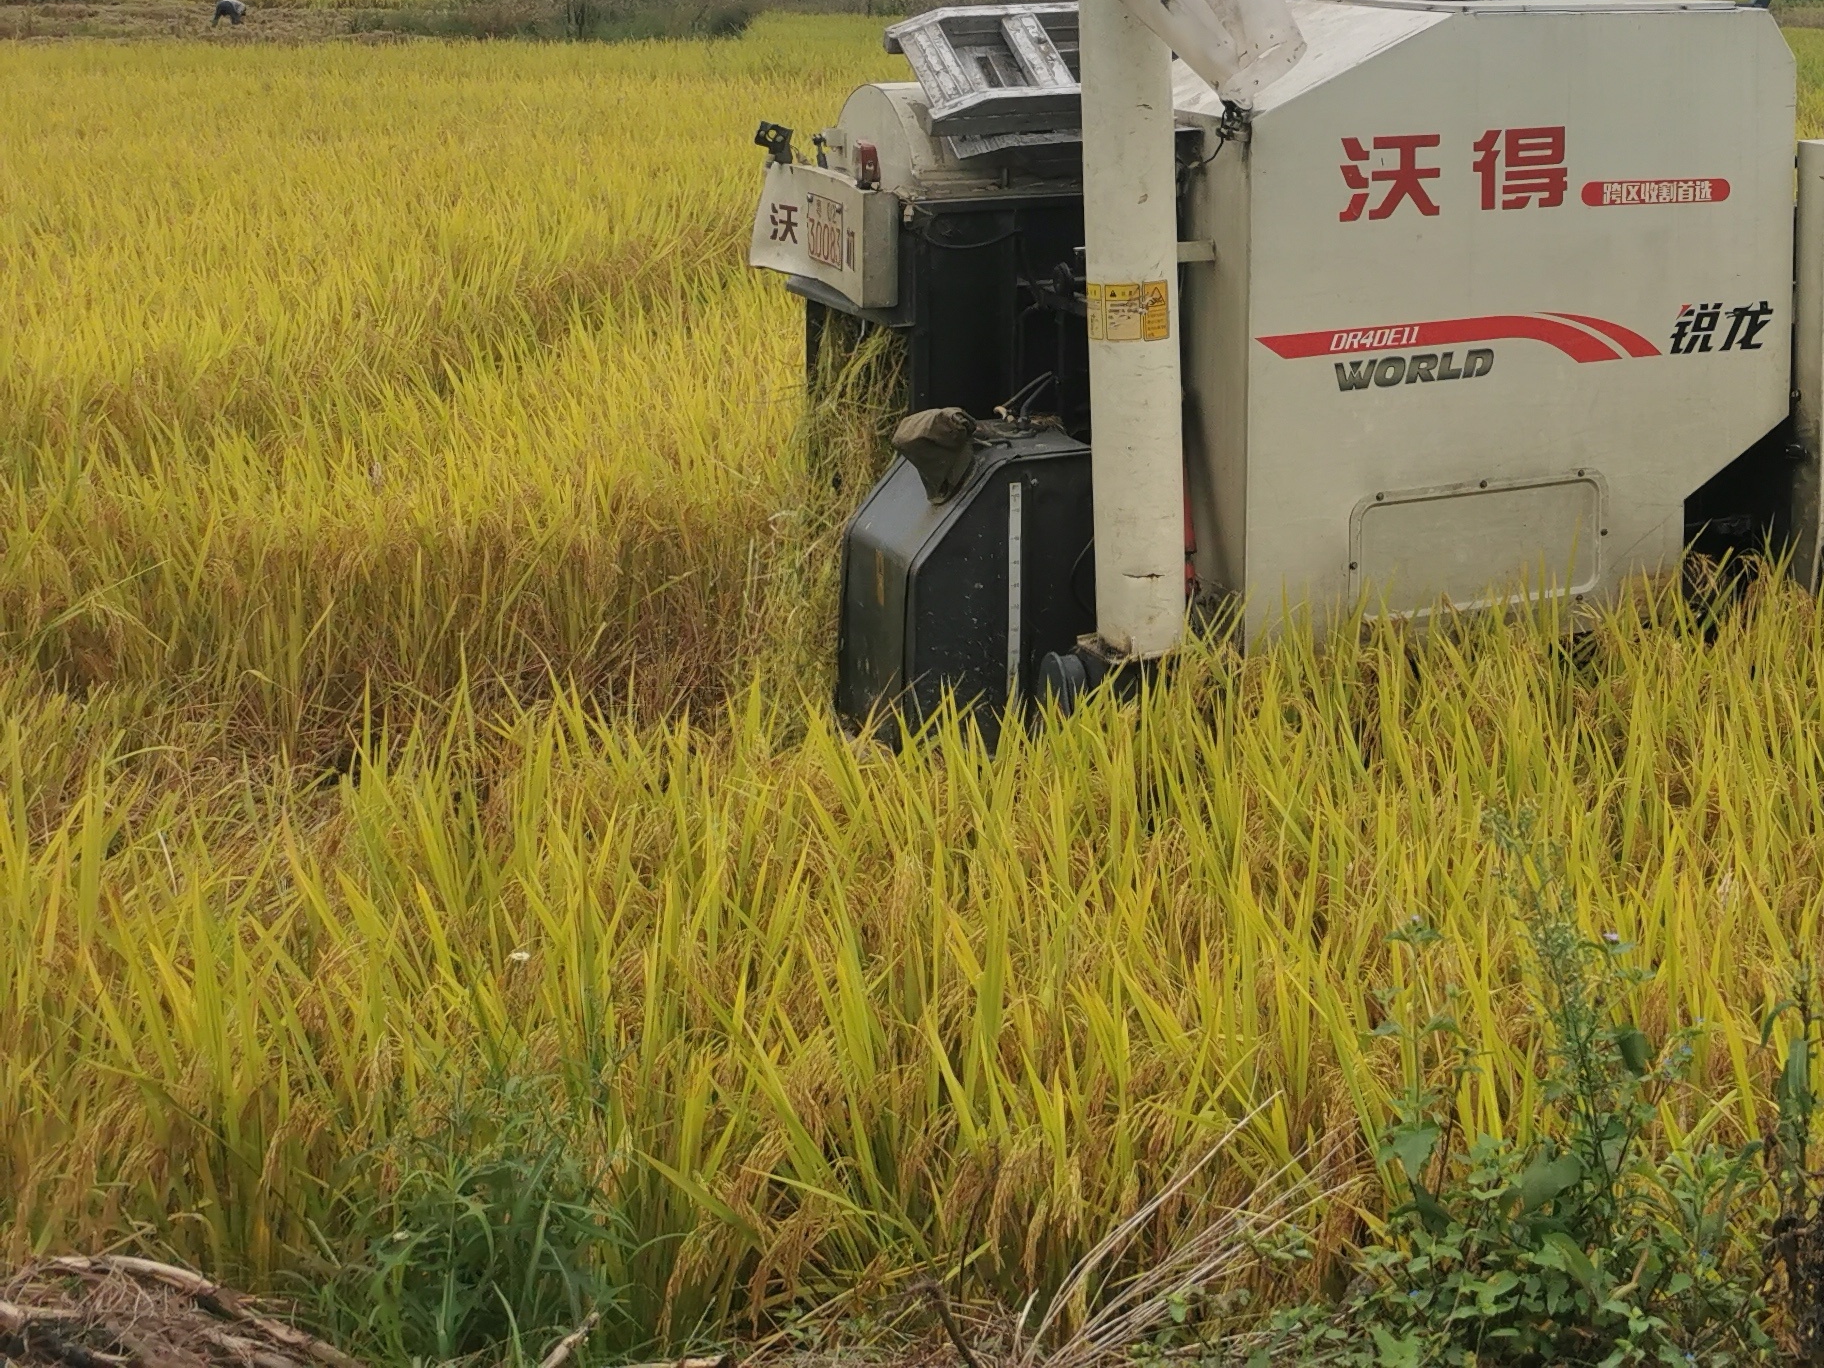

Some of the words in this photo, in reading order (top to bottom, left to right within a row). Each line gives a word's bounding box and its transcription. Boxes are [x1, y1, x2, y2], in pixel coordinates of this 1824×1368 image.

[1340, 126, 1567, 222] 沃得
[1603, 181, 1712, 205] 跨区收割首选
[1670, 301, 1774, 354] 锐龙
[1334, 347, 1494, 392] WORLD
